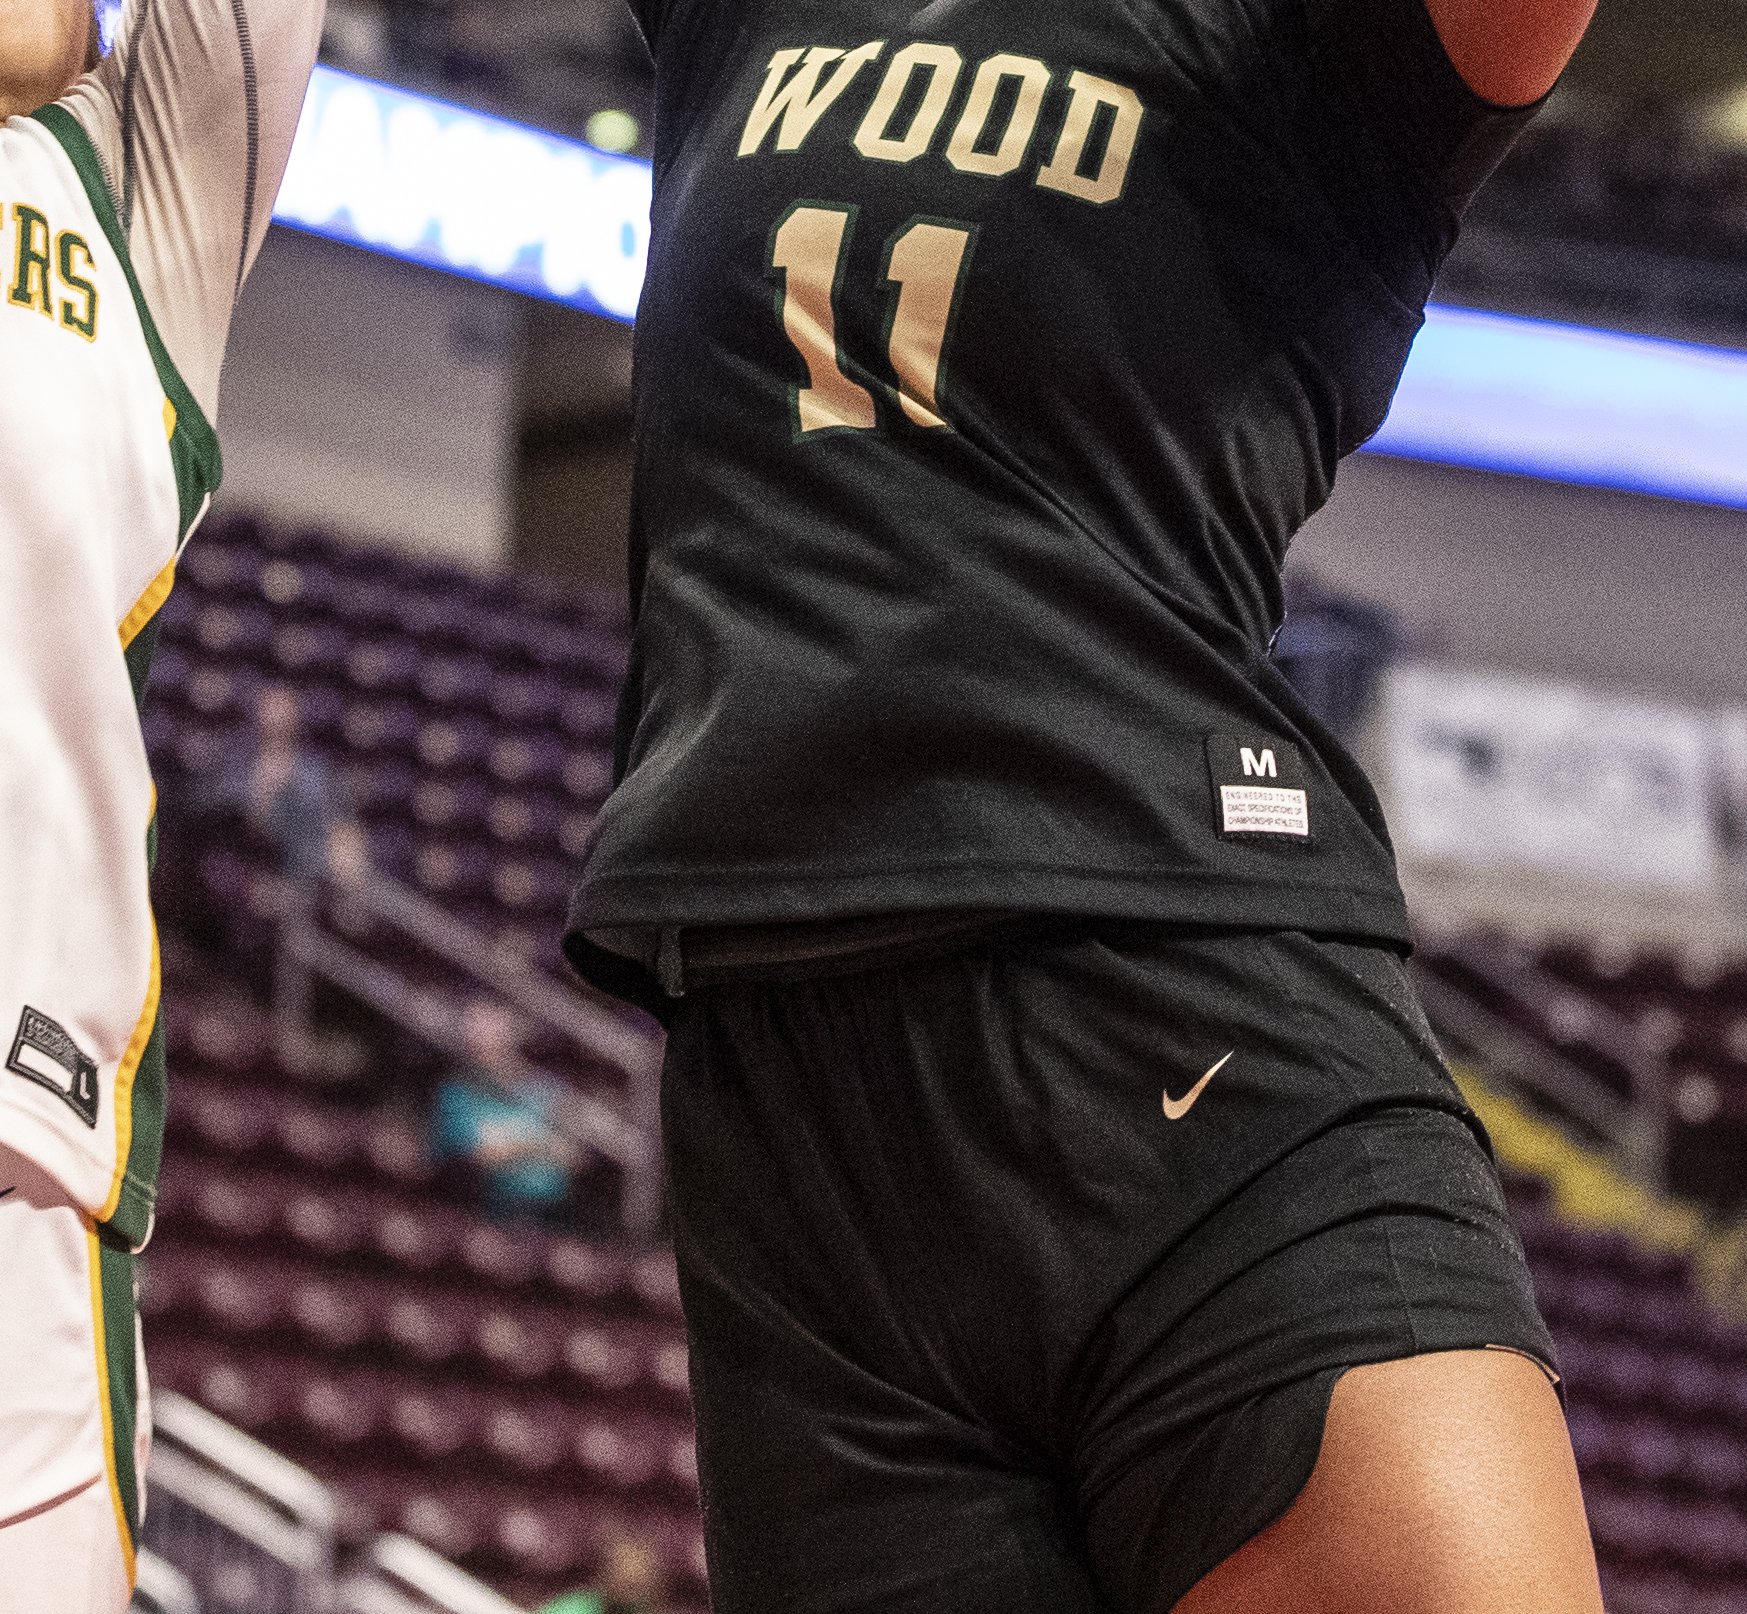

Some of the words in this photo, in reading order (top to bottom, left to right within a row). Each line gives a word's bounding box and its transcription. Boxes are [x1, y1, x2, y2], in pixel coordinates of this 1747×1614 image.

[737, 40, 1145, 206] WOOD
[769, 200, 979, 440] 11
[1238, 746, 1278, 778] M
